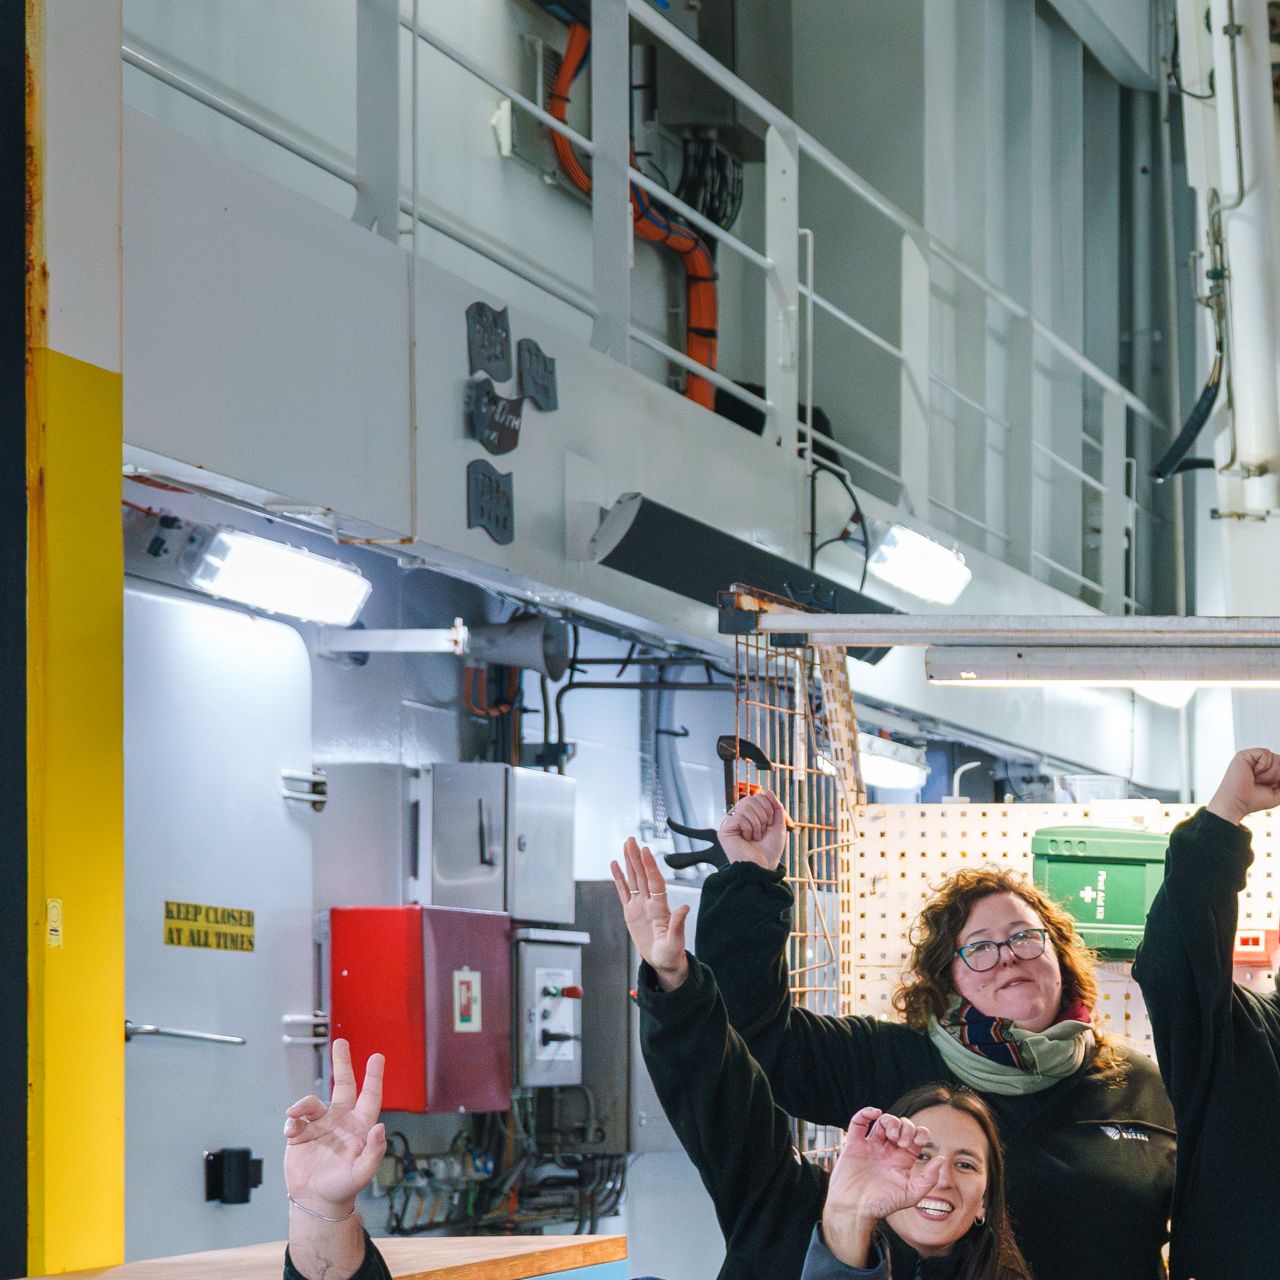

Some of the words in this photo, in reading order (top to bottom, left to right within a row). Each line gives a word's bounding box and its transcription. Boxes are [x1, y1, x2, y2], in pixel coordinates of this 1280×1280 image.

[1097, 870, 1107, 890] First
[1096, 891, 1105, 906] Aid
[164, 901, 202, 921] KEEP
[205, 906, 255, 928] CLOSED
[166, 927, 182, 946] AT
[188, 929, 210, 948] ALL
[212, 931, 255, 952] TIMES
